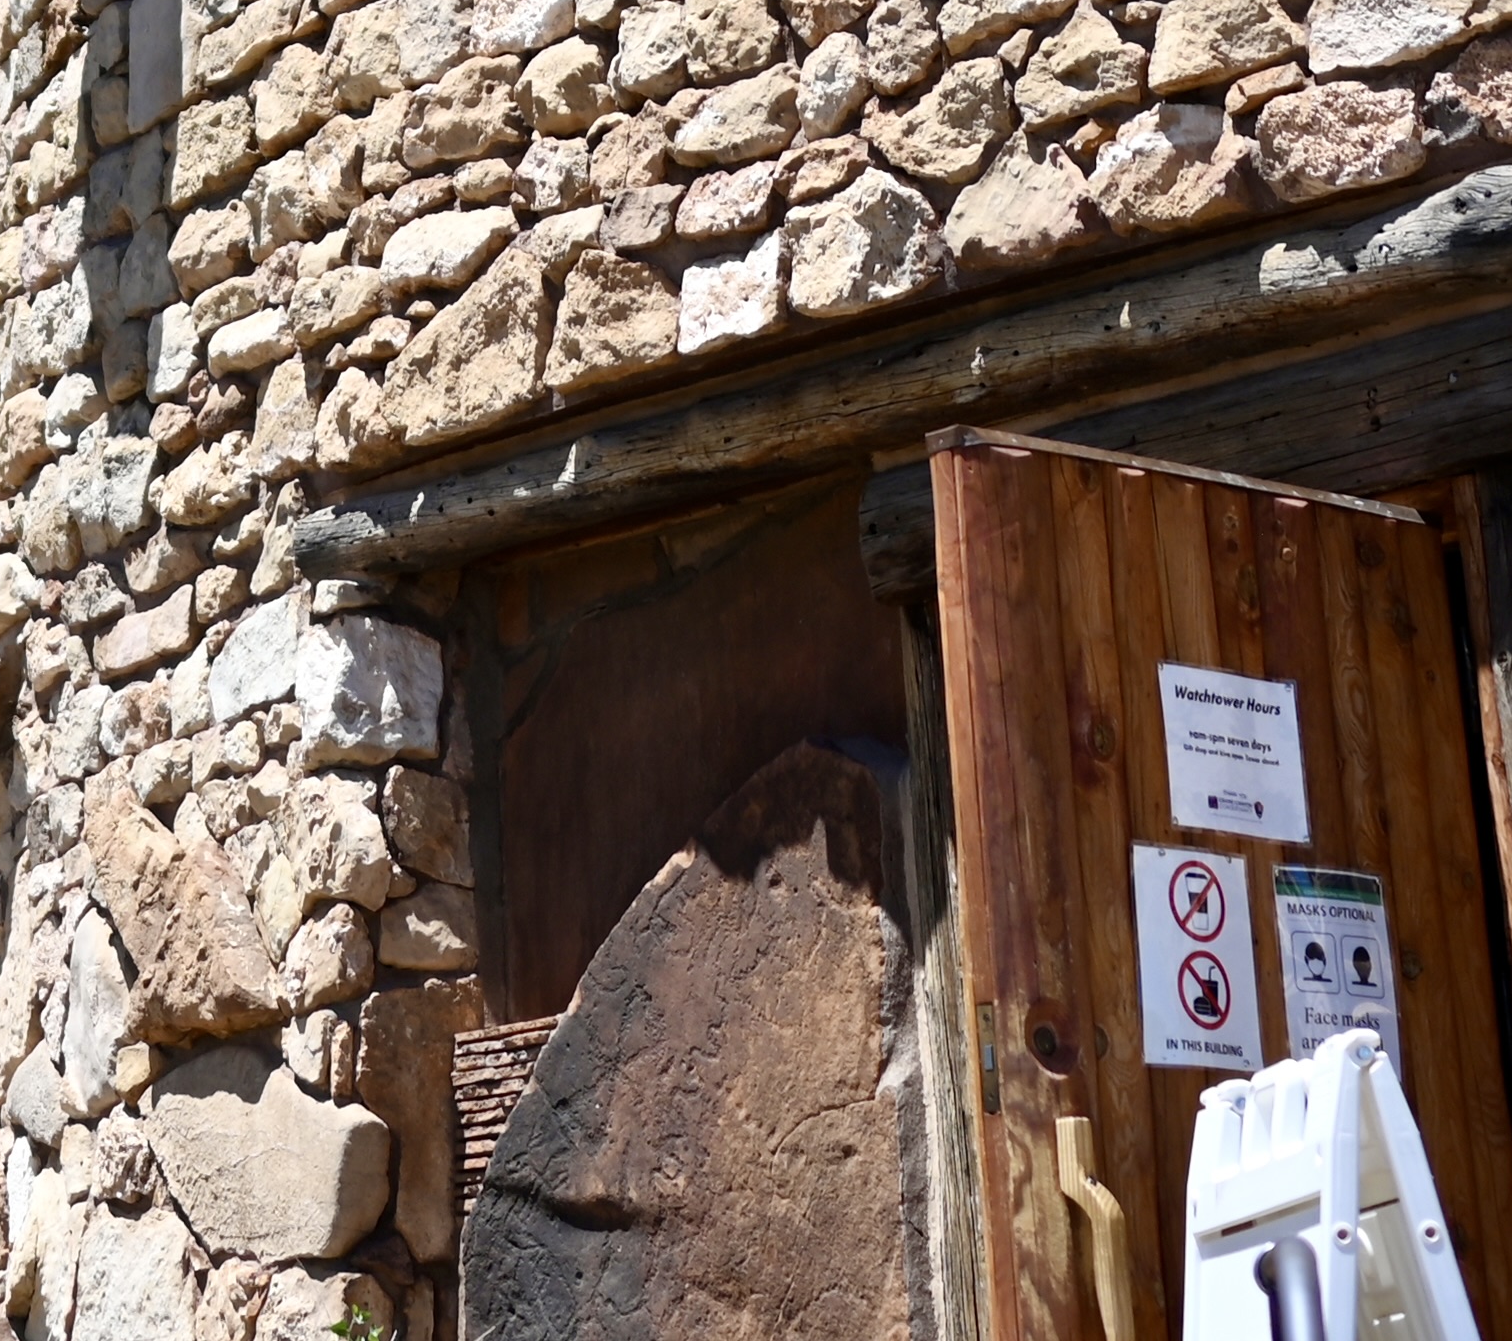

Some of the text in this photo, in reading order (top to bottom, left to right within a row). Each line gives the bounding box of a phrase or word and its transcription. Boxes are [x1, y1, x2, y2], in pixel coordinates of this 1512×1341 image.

[1175, 684, 1281, 716] Watchtower Hours
[1227, 737, 1249, 748] seven
[1251, 739, 1272, 754] days
[1287, 902, 1376, 923] MASKS OPTIONAL
[1304, 1007, 1380, 1030] Face masks
[1166, 1038, 1243, 1057] IN THIS BUILDING
